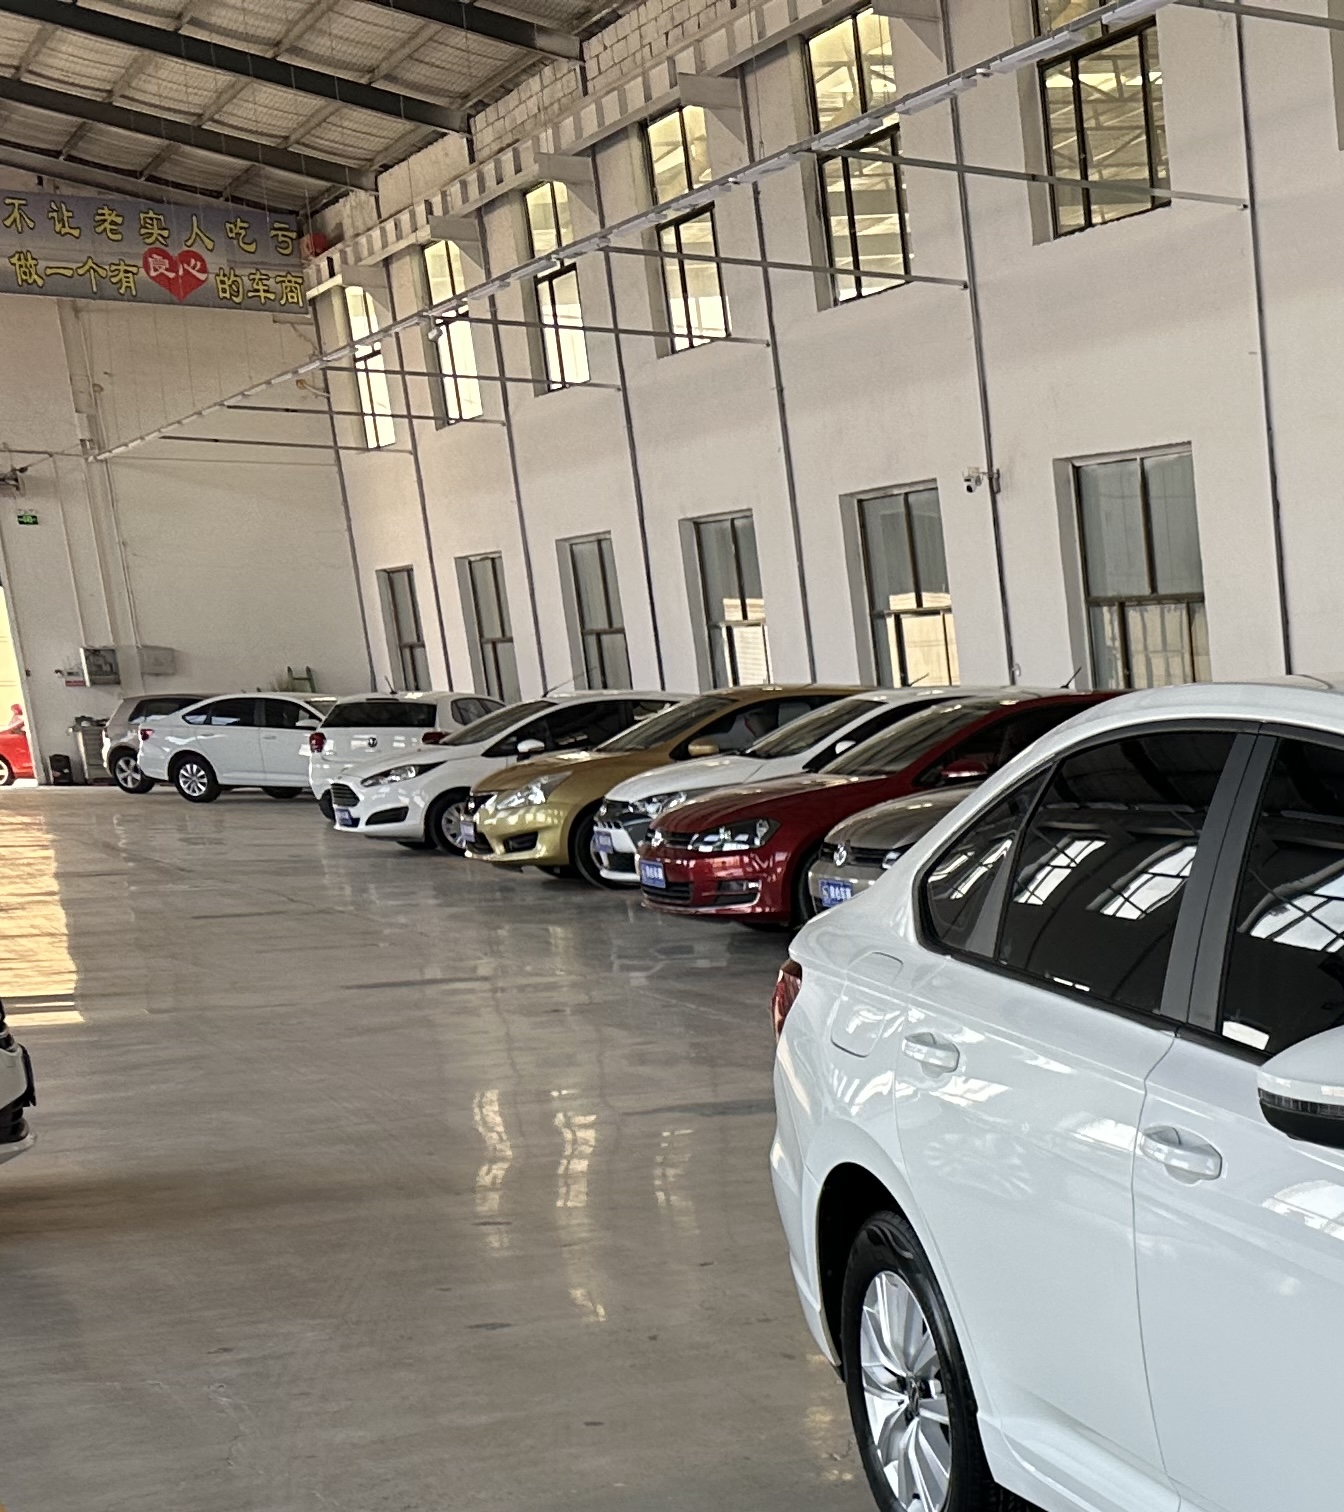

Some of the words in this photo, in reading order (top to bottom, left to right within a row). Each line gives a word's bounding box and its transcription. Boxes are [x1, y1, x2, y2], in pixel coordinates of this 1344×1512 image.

[2, 197, 298, 256] 不让老实人吃亏
[8, 250, 305, 308] 做一个有良心的车商
